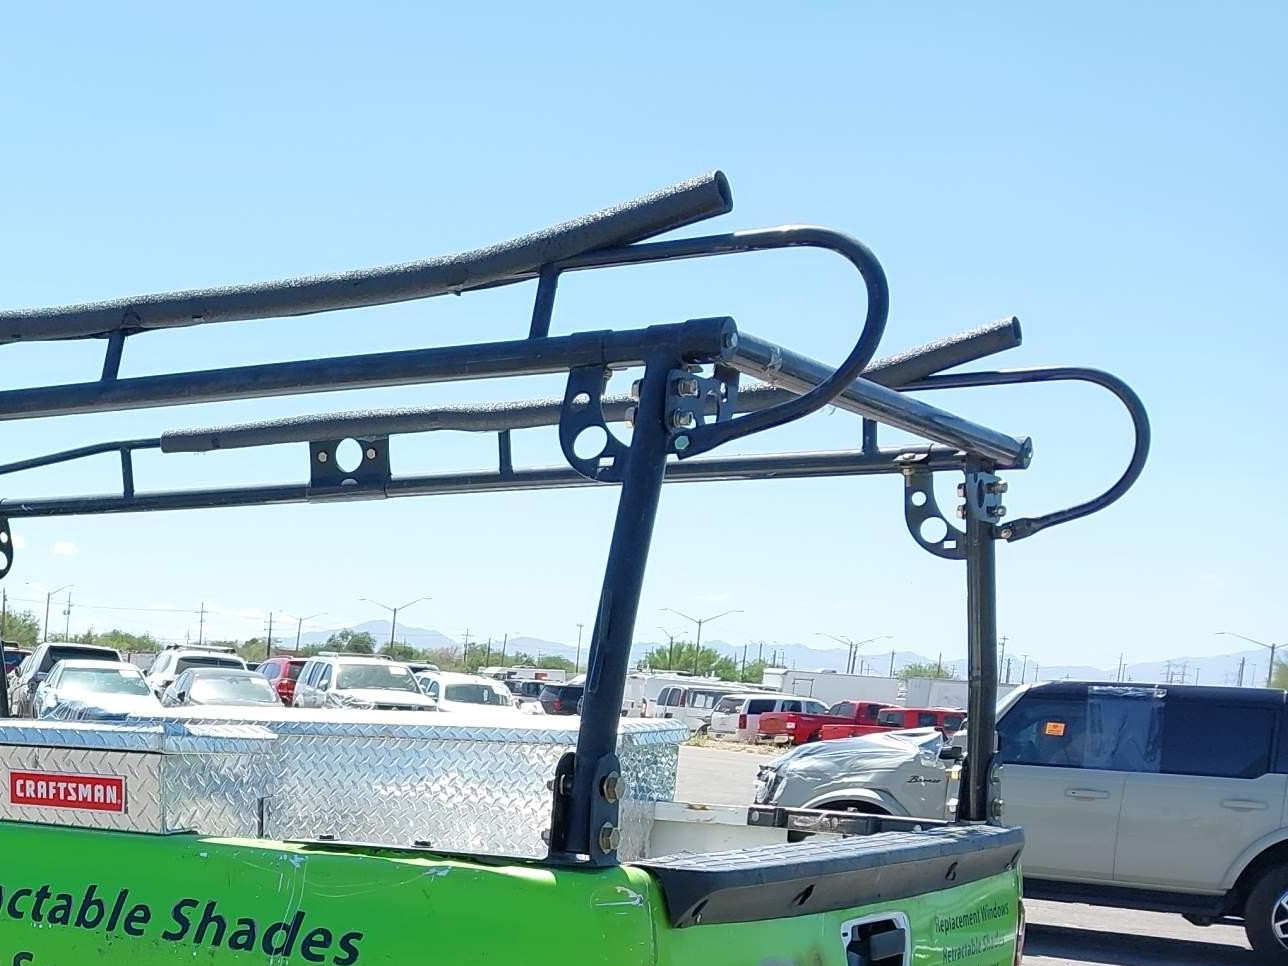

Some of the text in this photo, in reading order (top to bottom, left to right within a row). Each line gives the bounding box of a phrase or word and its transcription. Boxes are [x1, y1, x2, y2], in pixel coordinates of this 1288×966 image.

[15, 778, 118, 804] CRAFTSMAN
[935, 901, 1009, 934] Replacement Windows
